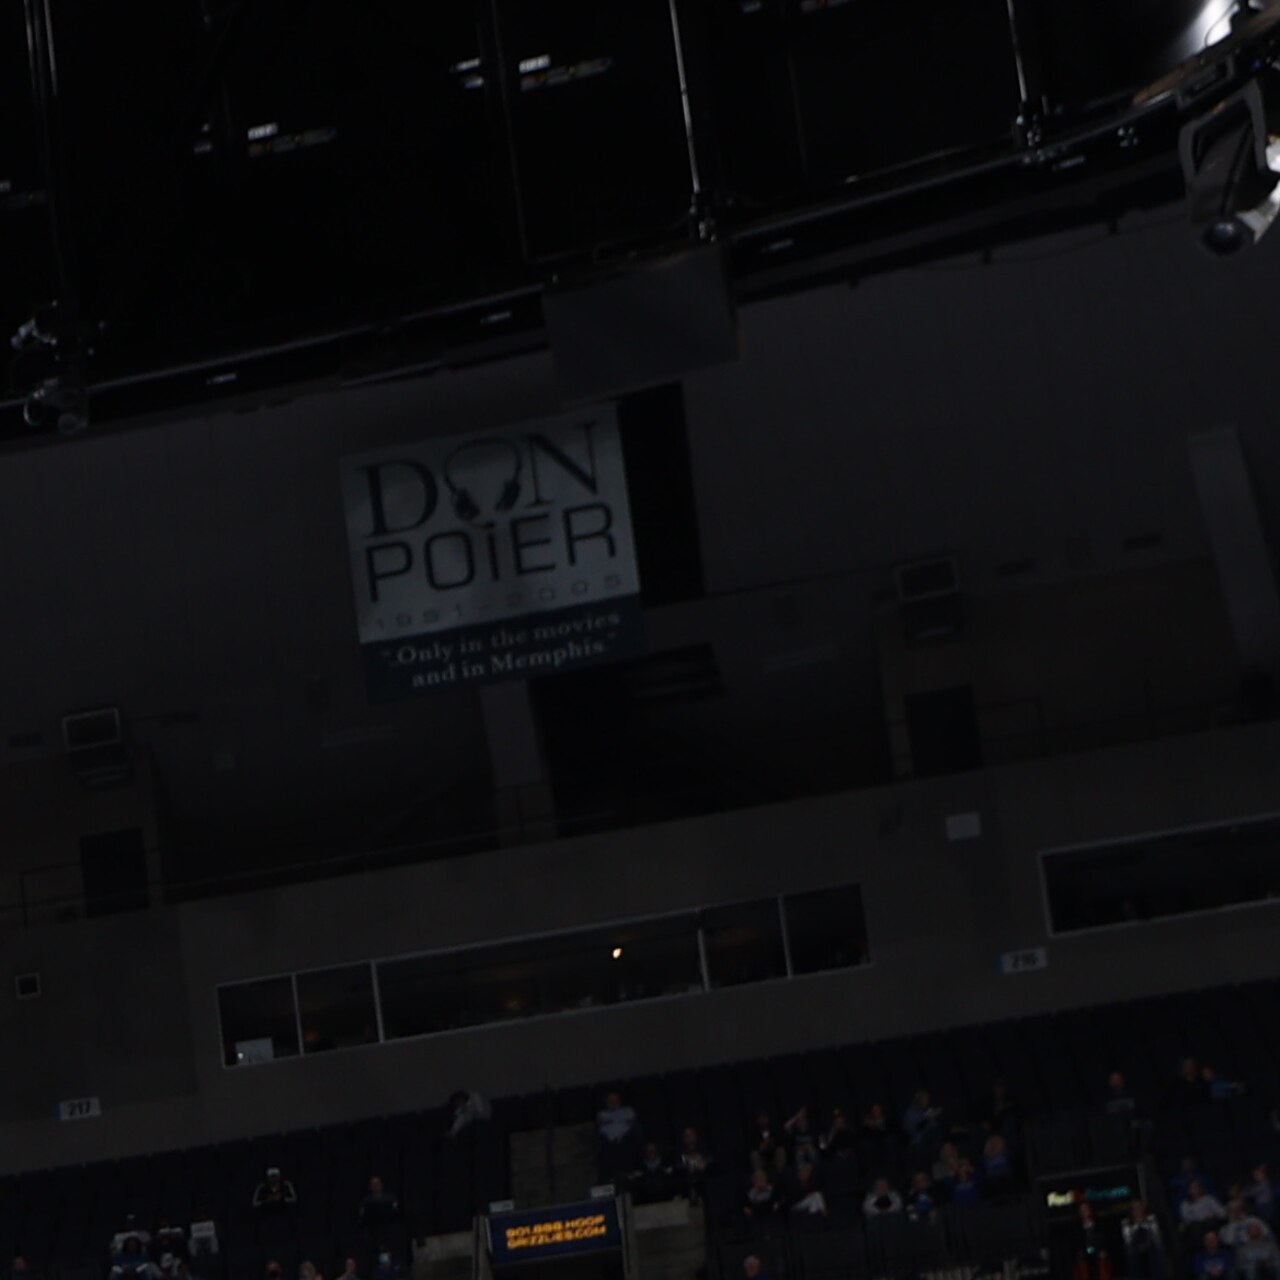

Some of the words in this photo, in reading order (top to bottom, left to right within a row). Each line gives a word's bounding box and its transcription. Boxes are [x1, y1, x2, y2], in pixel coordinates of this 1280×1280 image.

[460, 631, 483, 653] in
[490, 625, 527, 648] the
[533, 609, 621, 645] movies
[411, 663, 458, 688] and
[462, 658, 486, 680] in
